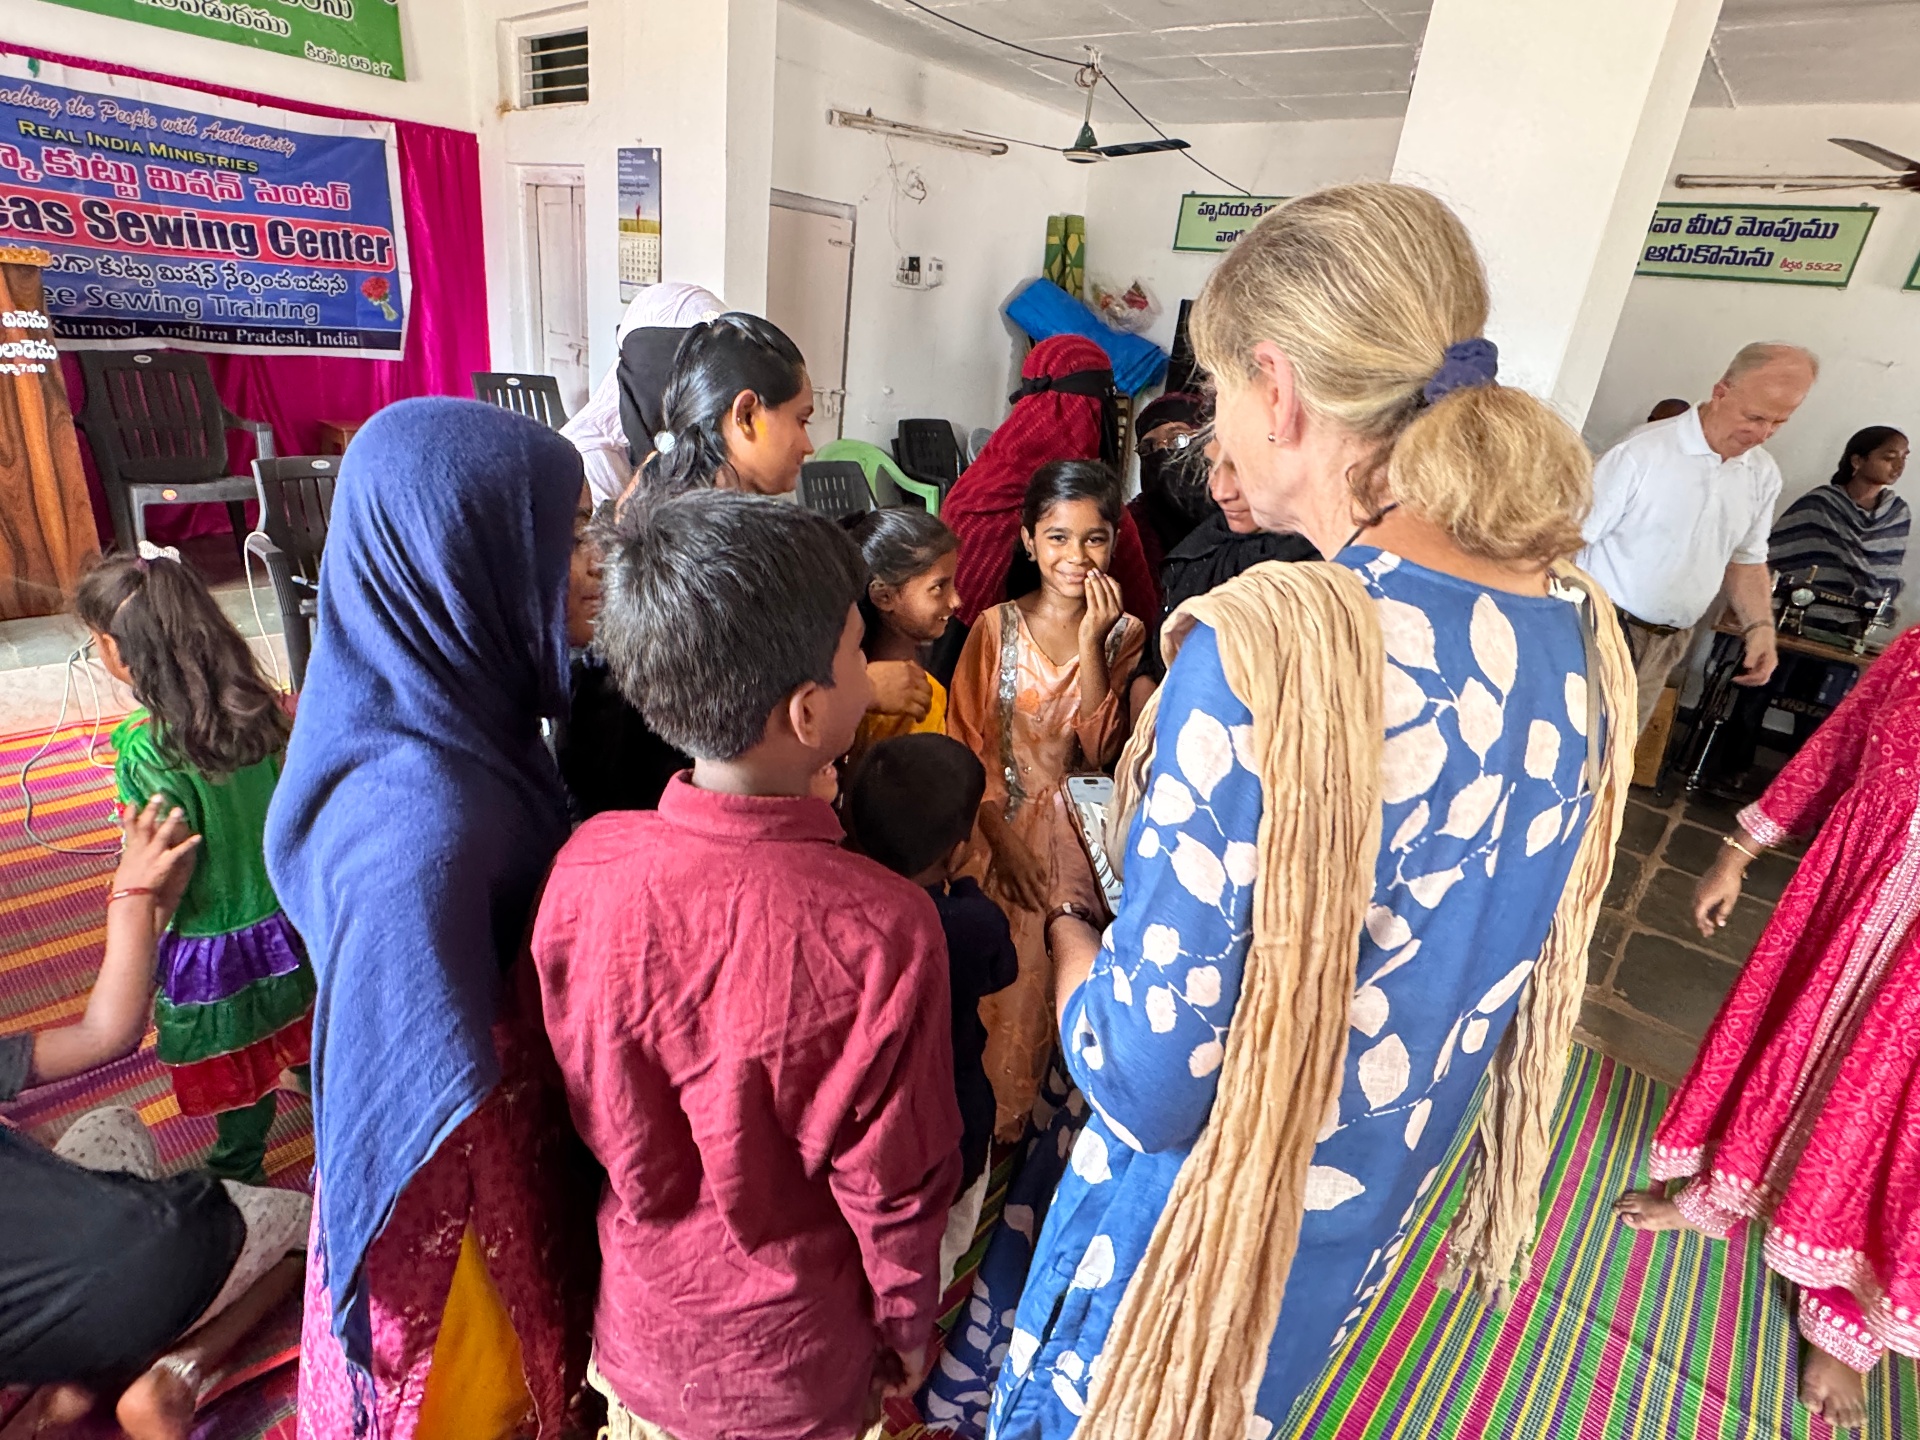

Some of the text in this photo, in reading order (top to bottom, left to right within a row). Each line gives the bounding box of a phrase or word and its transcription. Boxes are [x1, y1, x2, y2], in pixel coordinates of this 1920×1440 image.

[18, 120, 258, 172] REAL INDIA MINISTRIES
[66, 96, 95, 118] the
[98, 100, 157, 130] People
[162, 116, 198, 135] with
[201, 121, 297, 158] Authenticity
[41, 146, 140, 199] కుట్టు
[145, 164, 244, 202] మిషన్
[250, 178, 351, 211] సెంటర్
[79, 197, 260, 258] Sewing
[267, 218, 391, 266] Center
[96, 254, 156, 288] కుట్టు
[1805, 262, 1843, 272] 55:22
[84, 284, 202, 319] Sewing
[208, 294, 320, 325] Training
[152, 323, 228, 342] Andhra
[236, 329, 311, 346] Pradesh,
[317, 331, 359, 346] India
